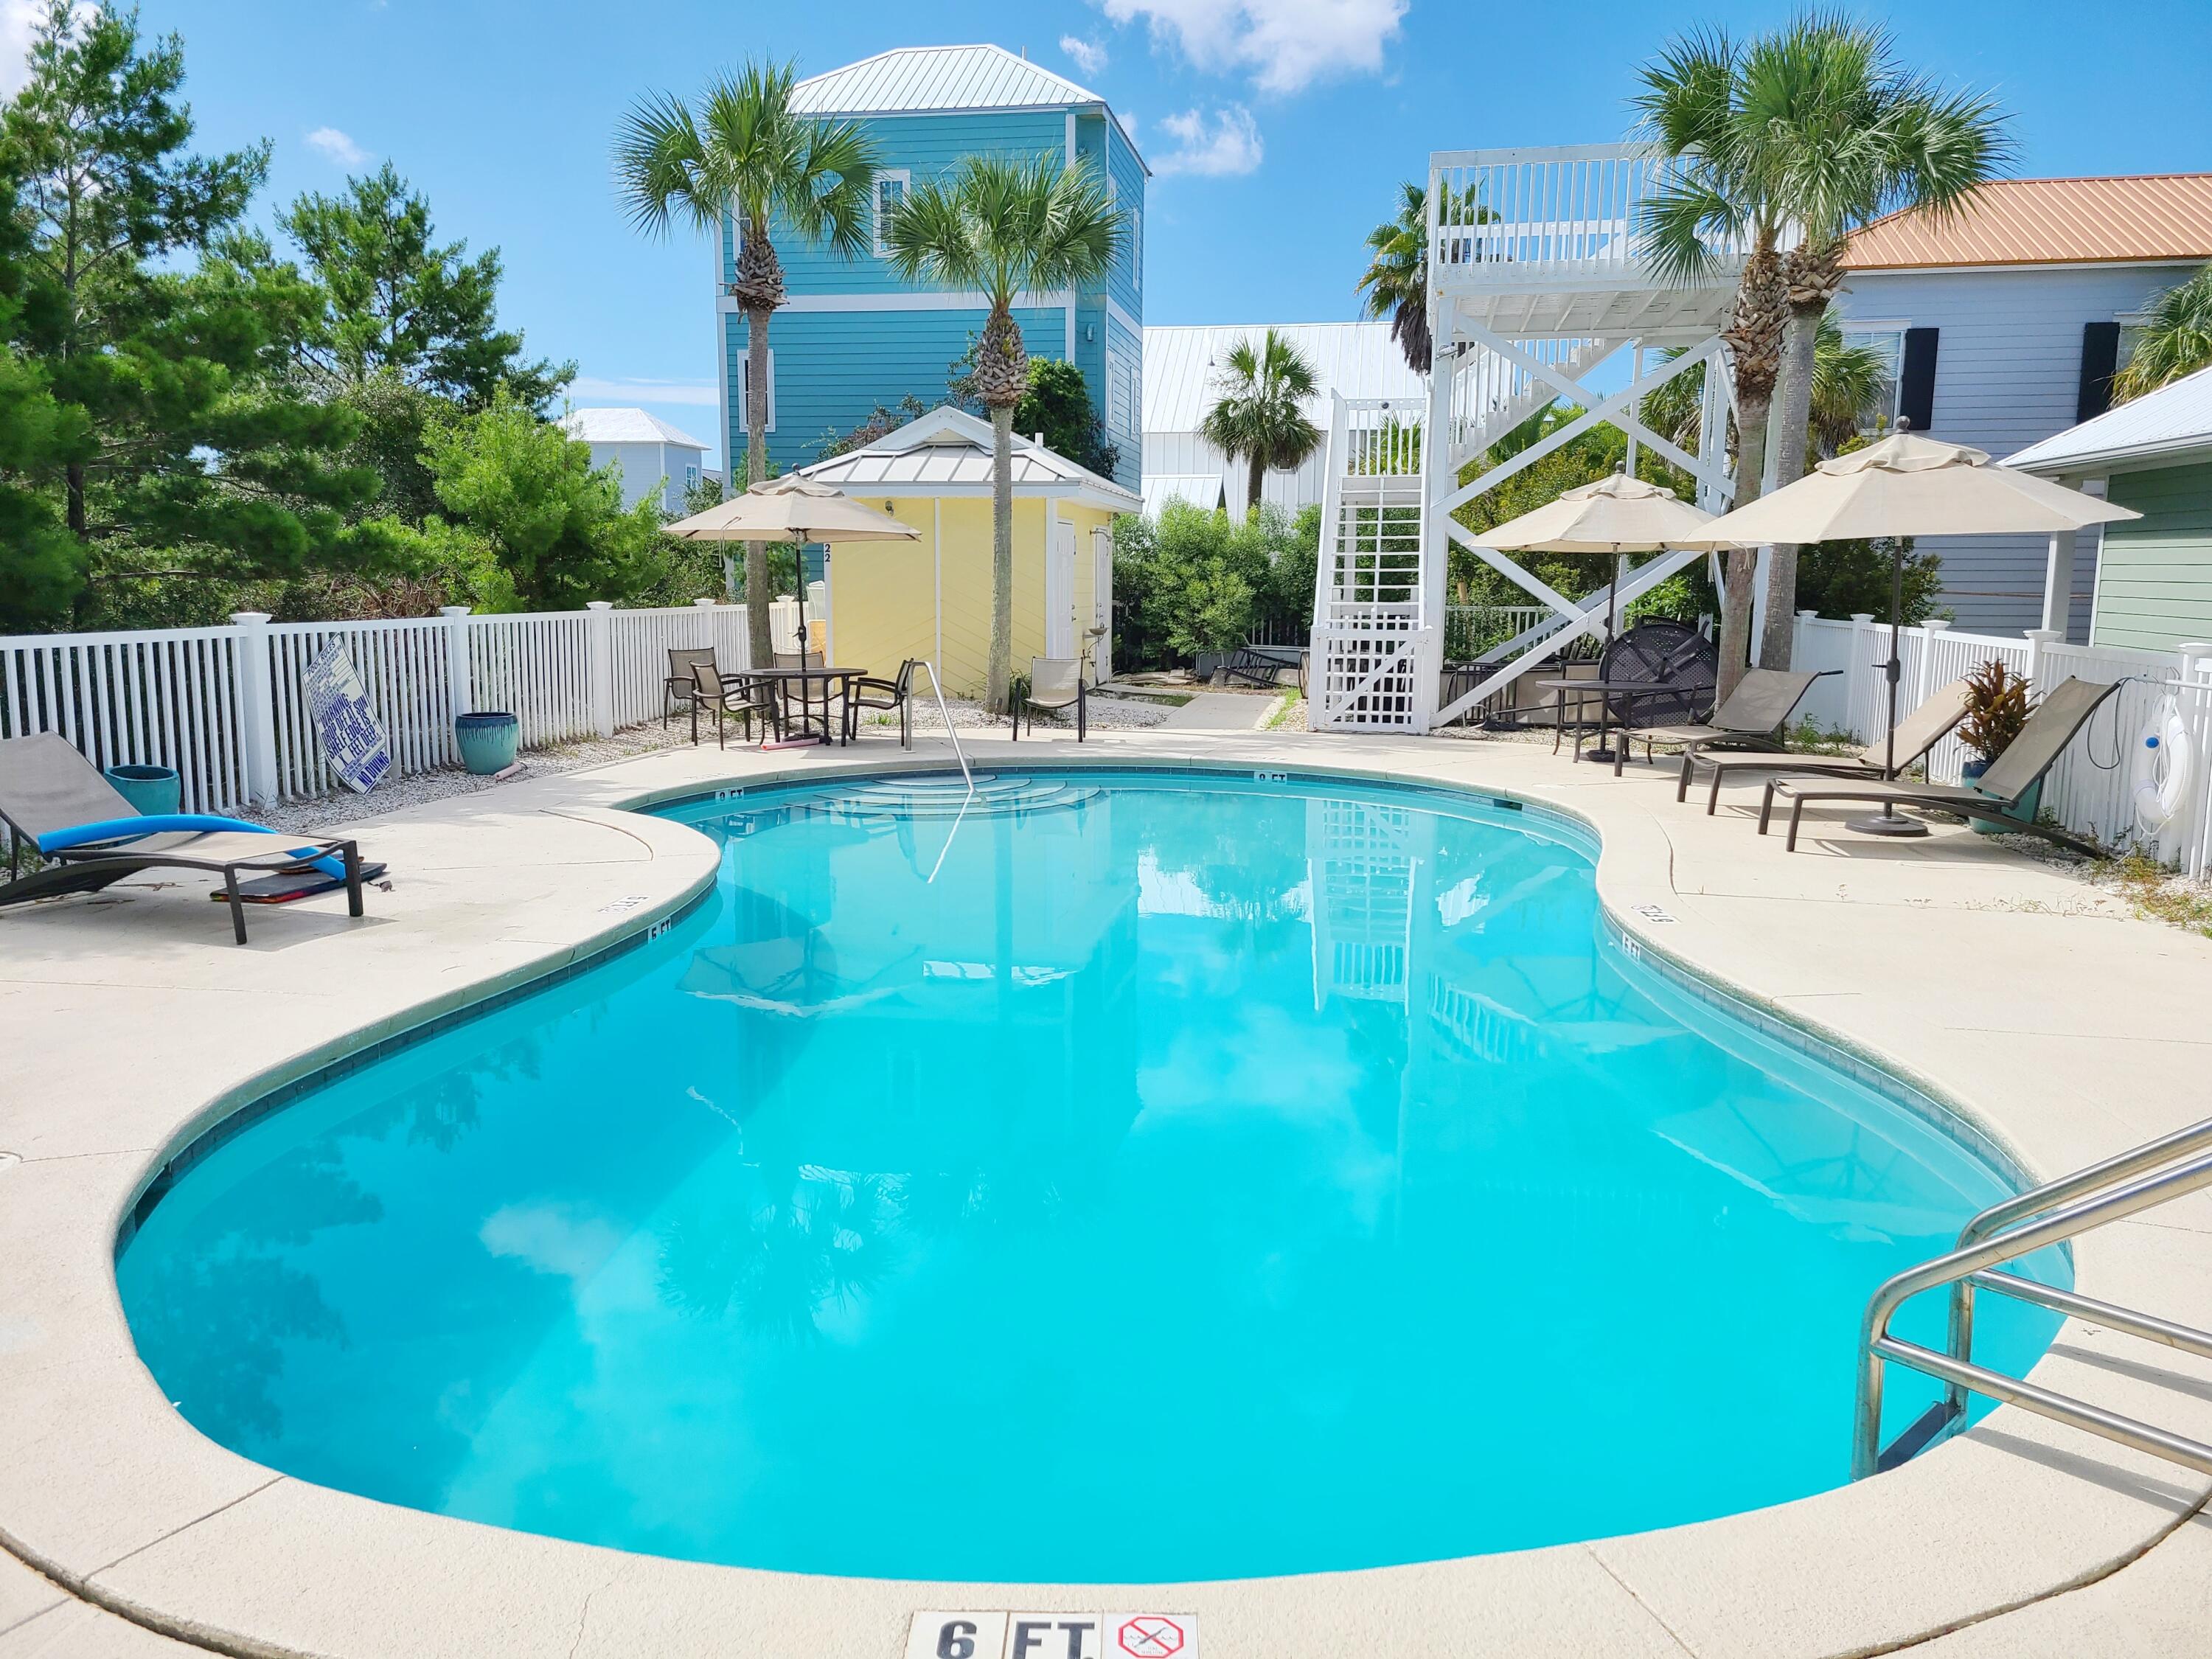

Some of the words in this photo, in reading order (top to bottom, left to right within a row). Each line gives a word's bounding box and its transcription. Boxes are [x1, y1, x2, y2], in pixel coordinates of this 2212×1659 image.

[307, 659, 320, 677] POOL
[321, 640, 335, 662] RULES
[321, 722, 338, 747] DROP
[335, 712, 349, 732] OFF
[346, 705, 356, 723] AT
[353, 695, 369, 715] SUN
[327, 731, 348, 759] SHELF
[344, 717, 364, 742] EDGE
[360, 711, 371, 728] IS
[348, 737, 365, 758] FEET
[356, 771, 372, 787] NO
[364, 751, 389, 779] DIVING
[651, 927, 657, 940] 5
[661, 919, 670, 935] FT
[936, 1620, 977, 1659] 6
